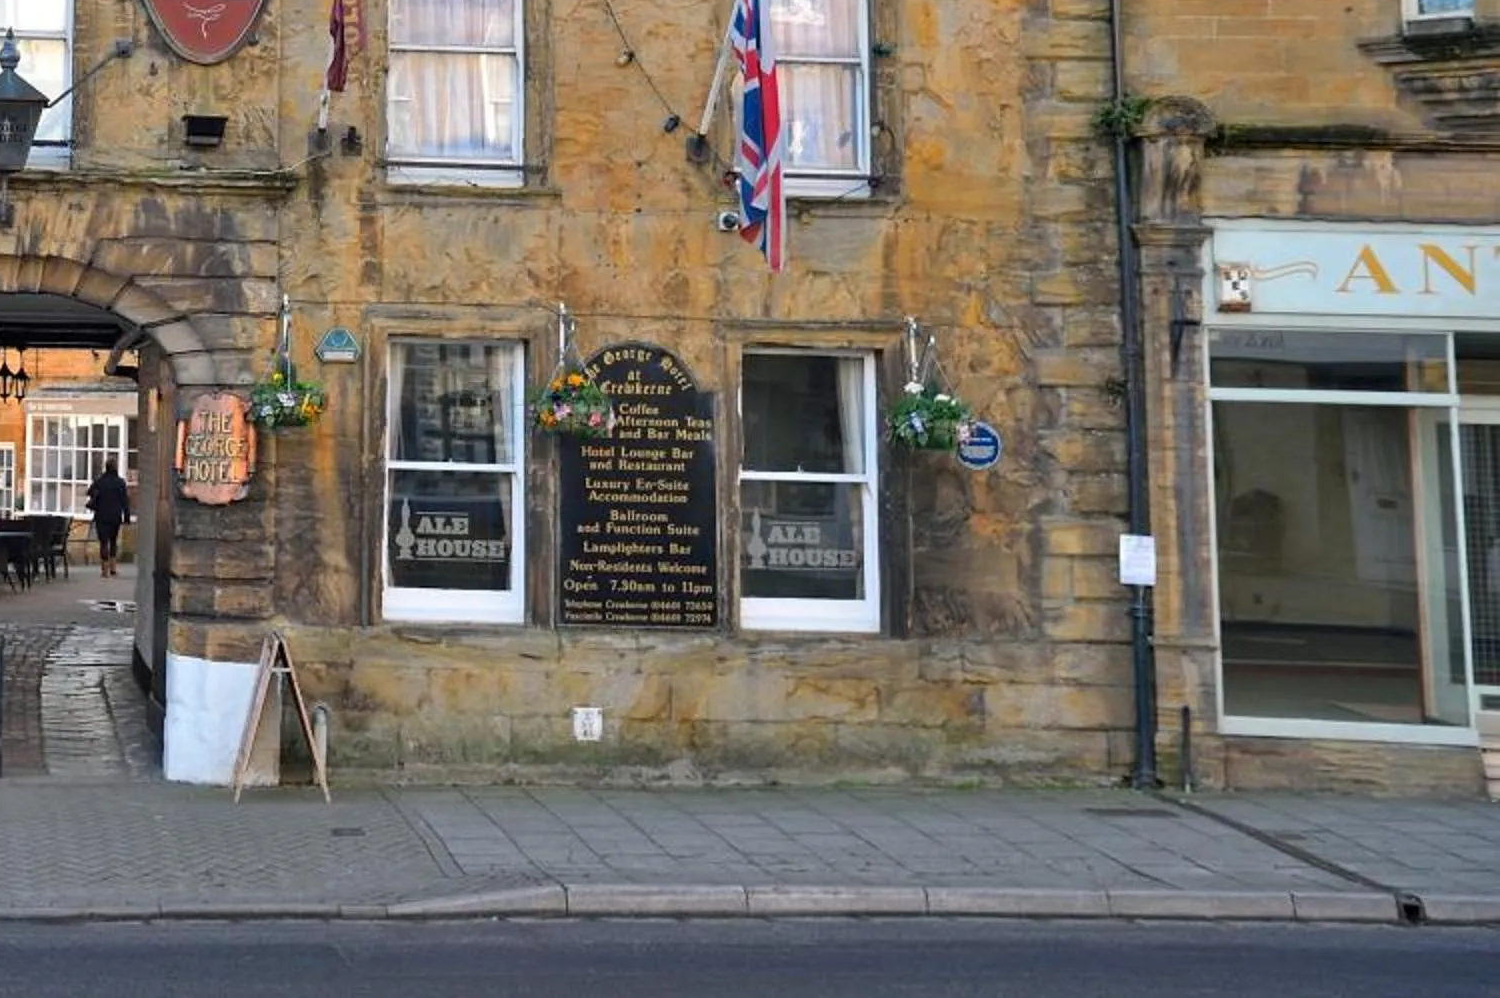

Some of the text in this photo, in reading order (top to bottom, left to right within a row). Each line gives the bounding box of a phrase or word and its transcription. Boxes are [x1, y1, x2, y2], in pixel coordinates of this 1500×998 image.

[1334, 242, 1500, 296] AN
[603, 349, 653, 365] George
[660, 355, 694, 391] Hotel
[627, 369, 641, 382] at
[600, 380, 672, 395] Crewkerne
[619, 403, 660, 415] Coffee
[198, 410, 232, 433] THE
[616, 415, 712, 428] Afternoon Teas
[619, 428, 712, 441] and Bar Meals
[186, 434, 245, 457] GEORGE
[581, 446, 695, 460] Hotel Lounge Bar
[187, 460, 240, 482] HOTEL
[589, 459, 686, 472] and Restaurant
[585, 477, 690, 491] Luxury En-Suite
[588, 491, 689, 503] Accommodation
[609, 509, 669, 522] Ballroom
[416, 515, 469, 535] ALE
[577, 522, 700, 536] and Function Suite
[767, 525, 821, 544] ALE
[415, 538, 505, 559] HOUSE
[583, 540, 691, 556] Lamplighters Bar
[766, 548, 858, 567] HOUSE
[569, 559, 707, 574] Non-Residents Welcome
[563, 579, 713, 596] Open 7.30am to 11pm
